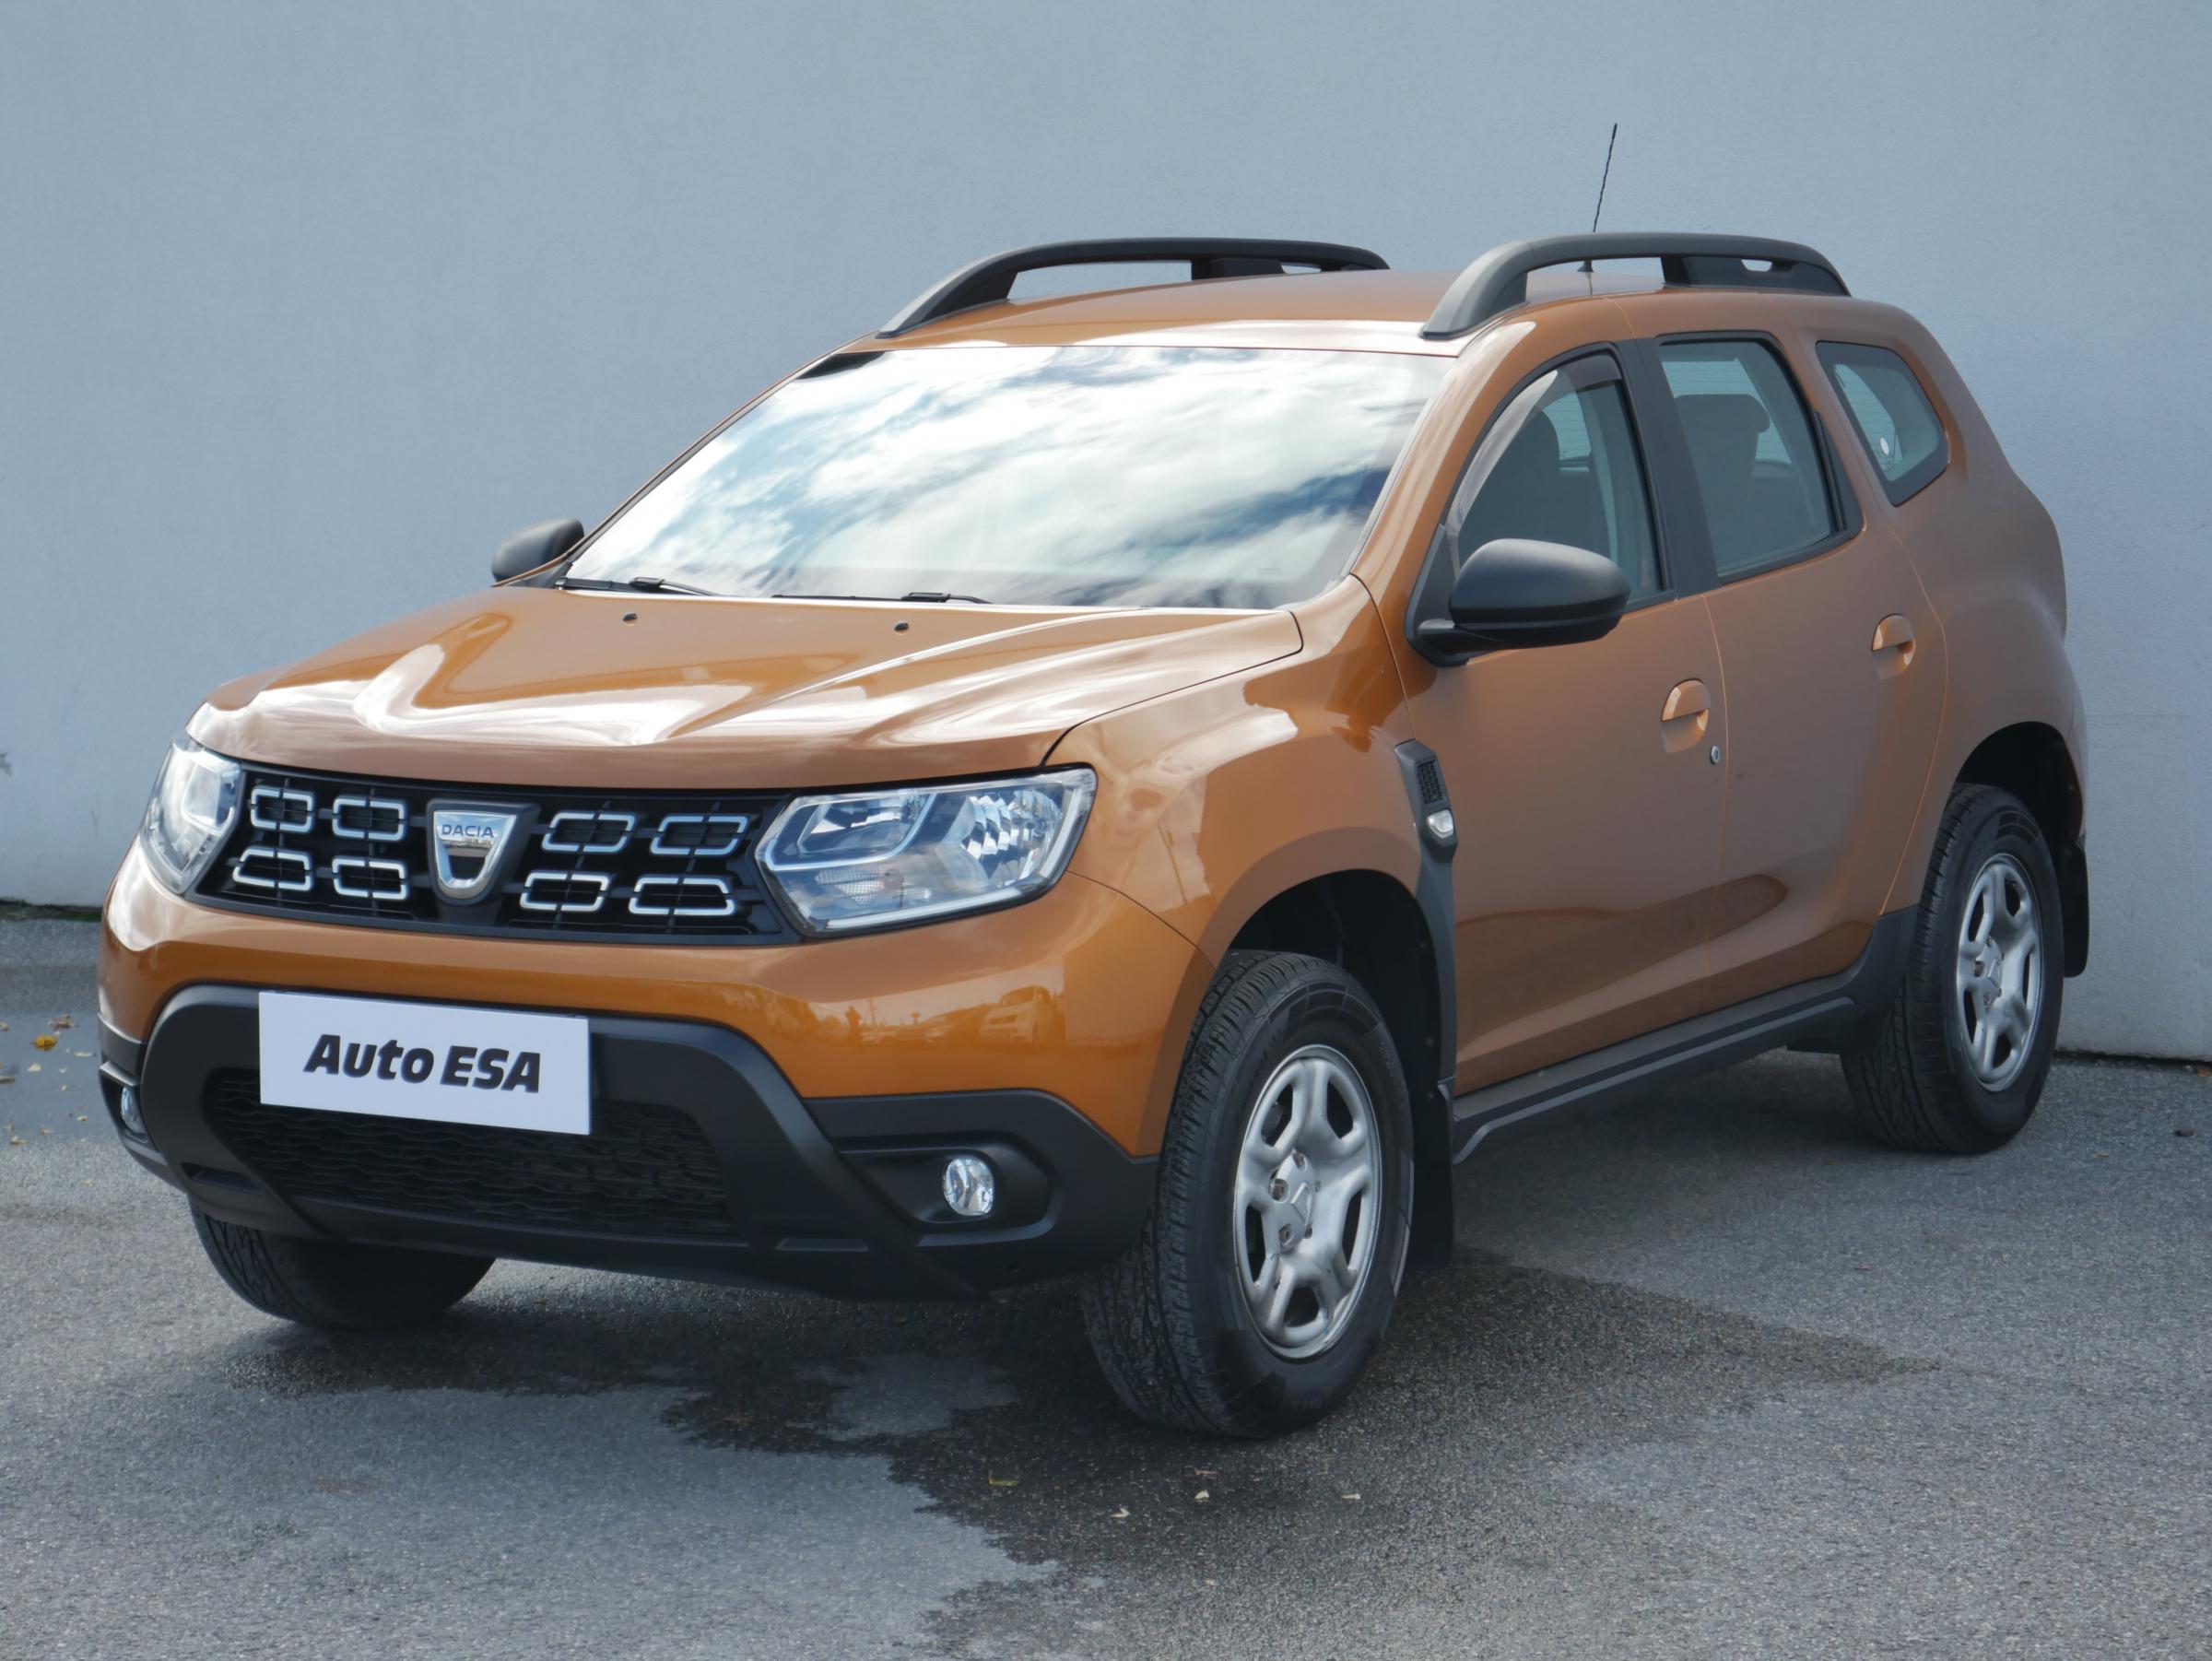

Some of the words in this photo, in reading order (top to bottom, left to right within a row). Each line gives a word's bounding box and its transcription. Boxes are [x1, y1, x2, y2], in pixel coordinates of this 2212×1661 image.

[441, 824, 495, 839] DACIA
[303, 1034, 434, 1083] Auto
[440, 1045, 541, 1093] ESA
